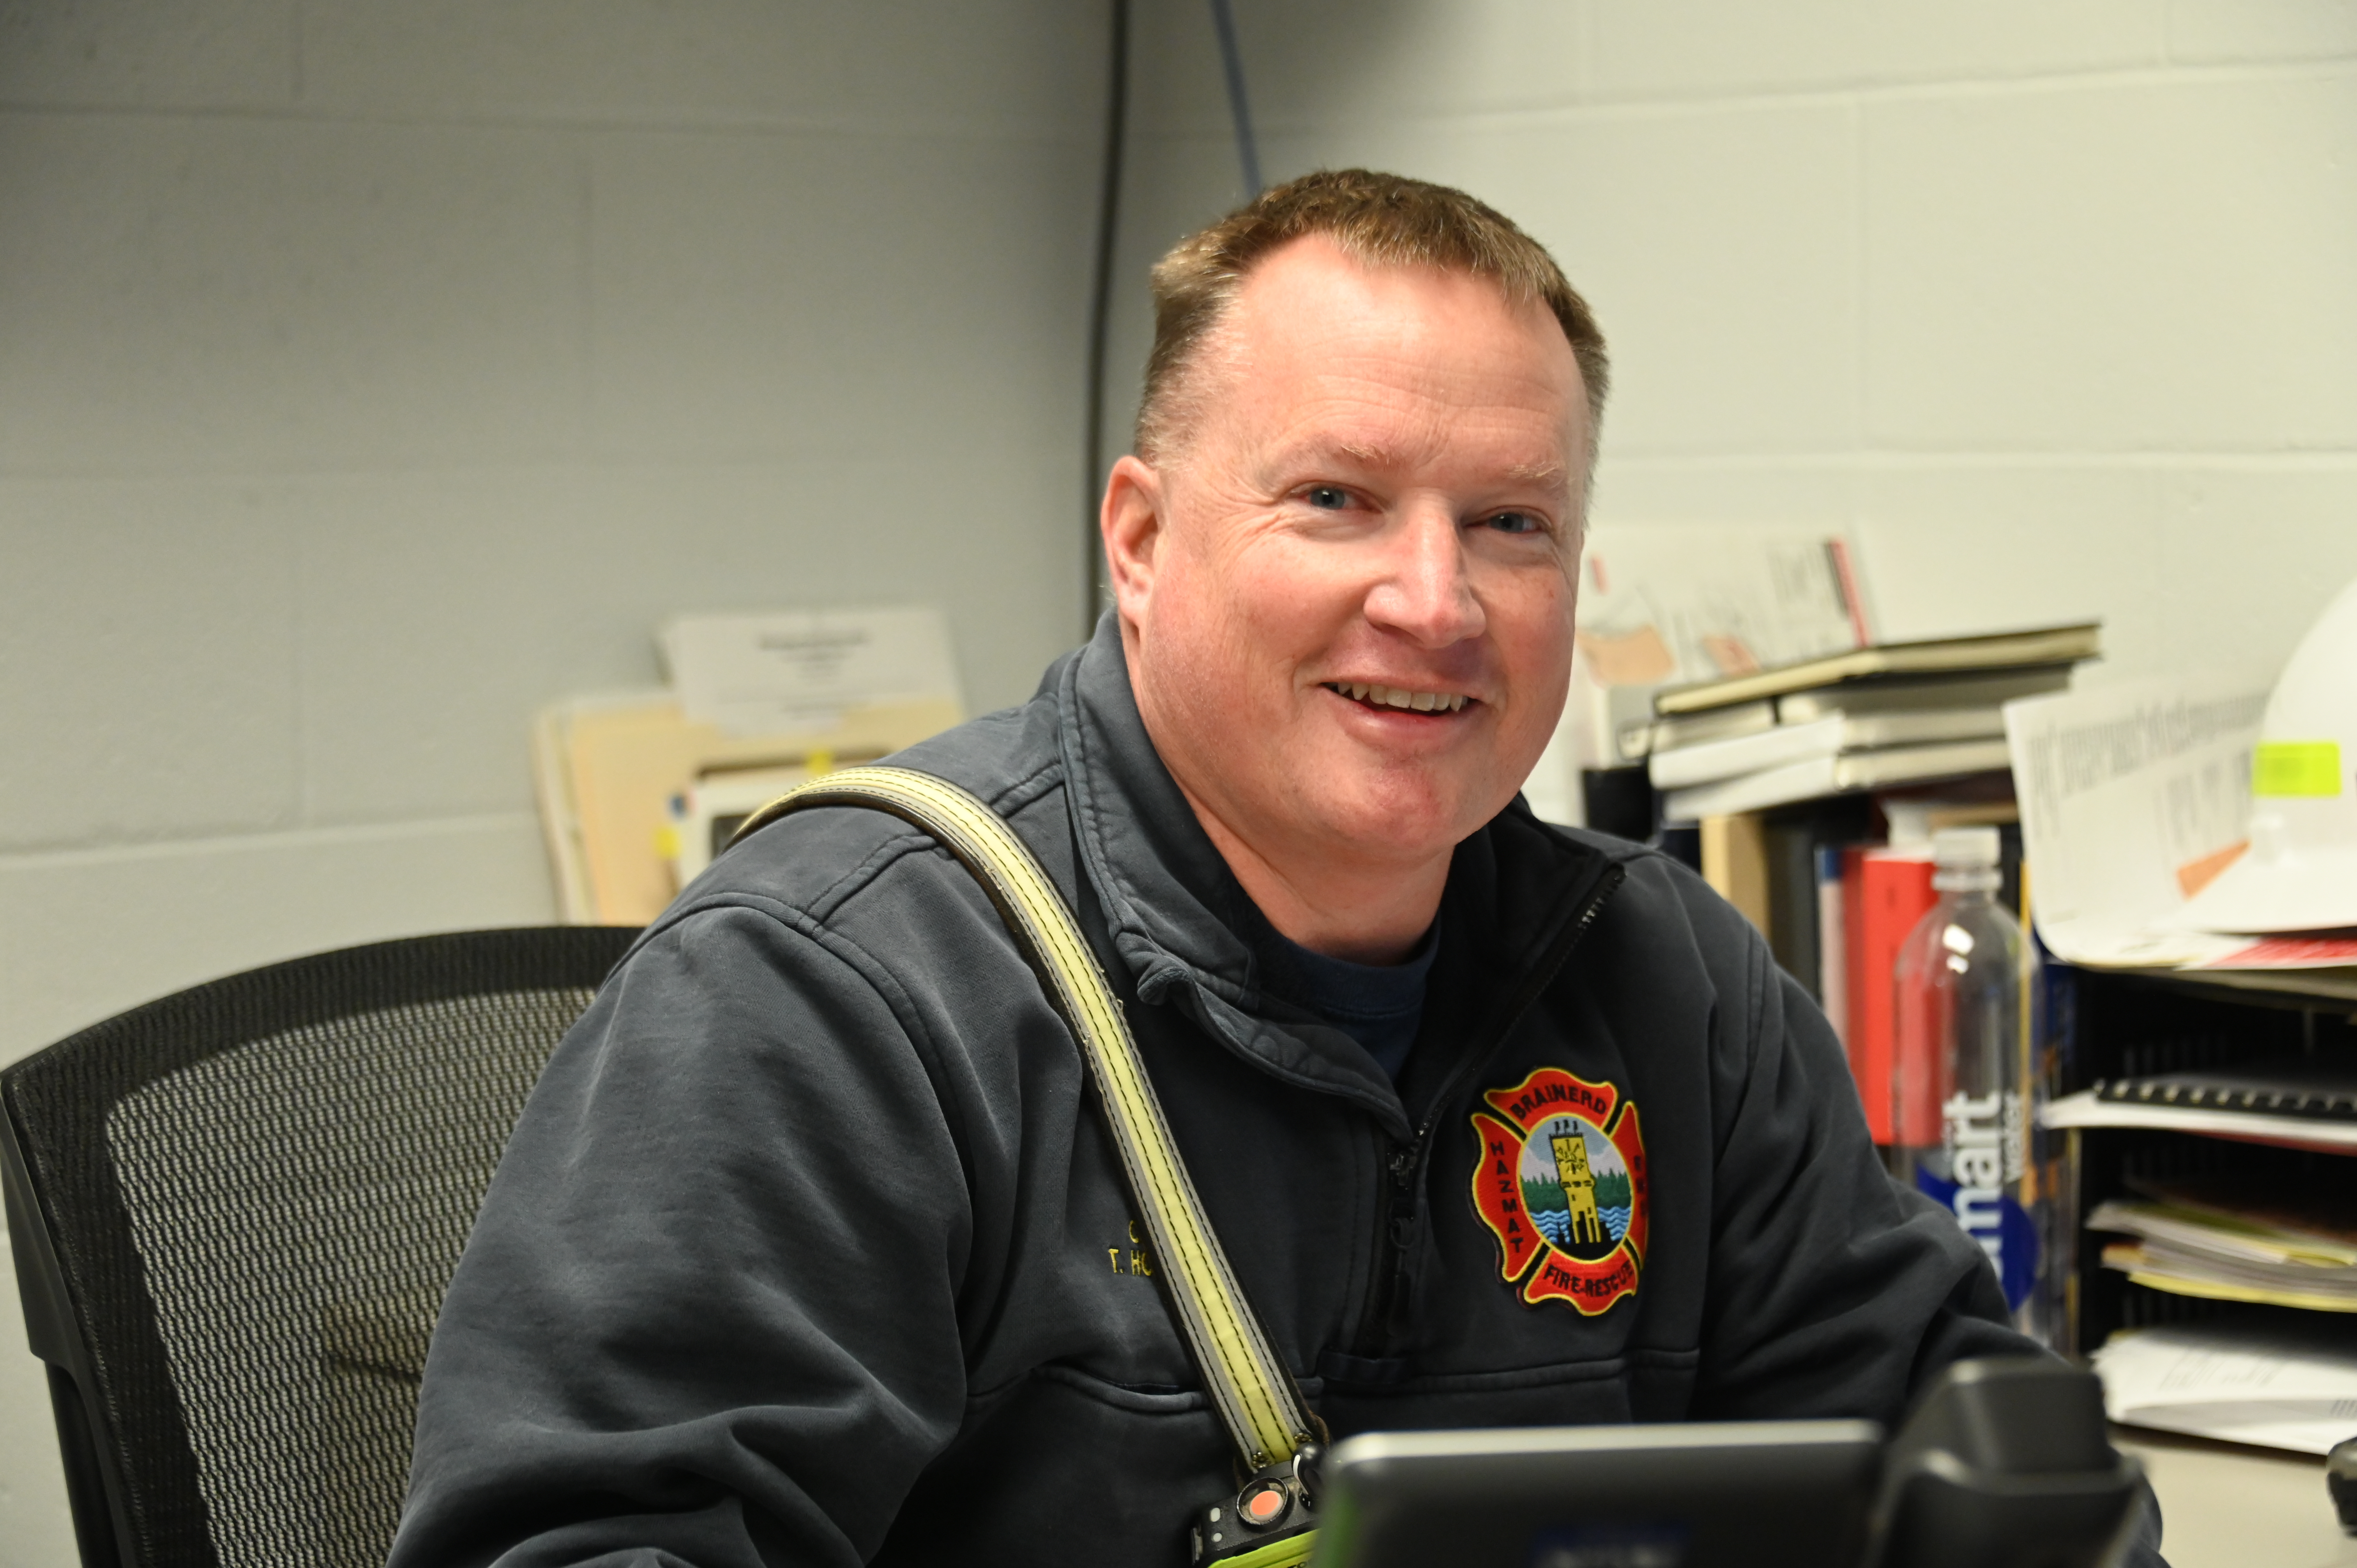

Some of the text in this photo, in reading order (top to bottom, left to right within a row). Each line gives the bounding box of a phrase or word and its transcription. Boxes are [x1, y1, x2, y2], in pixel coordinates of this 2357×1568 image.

[1509, 1084, 1606, 1121] BRAINERD
[1490, 1141, 1523, 1253] HAZMAT
[1942, 1090, 2004, 1282] mart
[1108, 1248, 1124, 1273] T.
